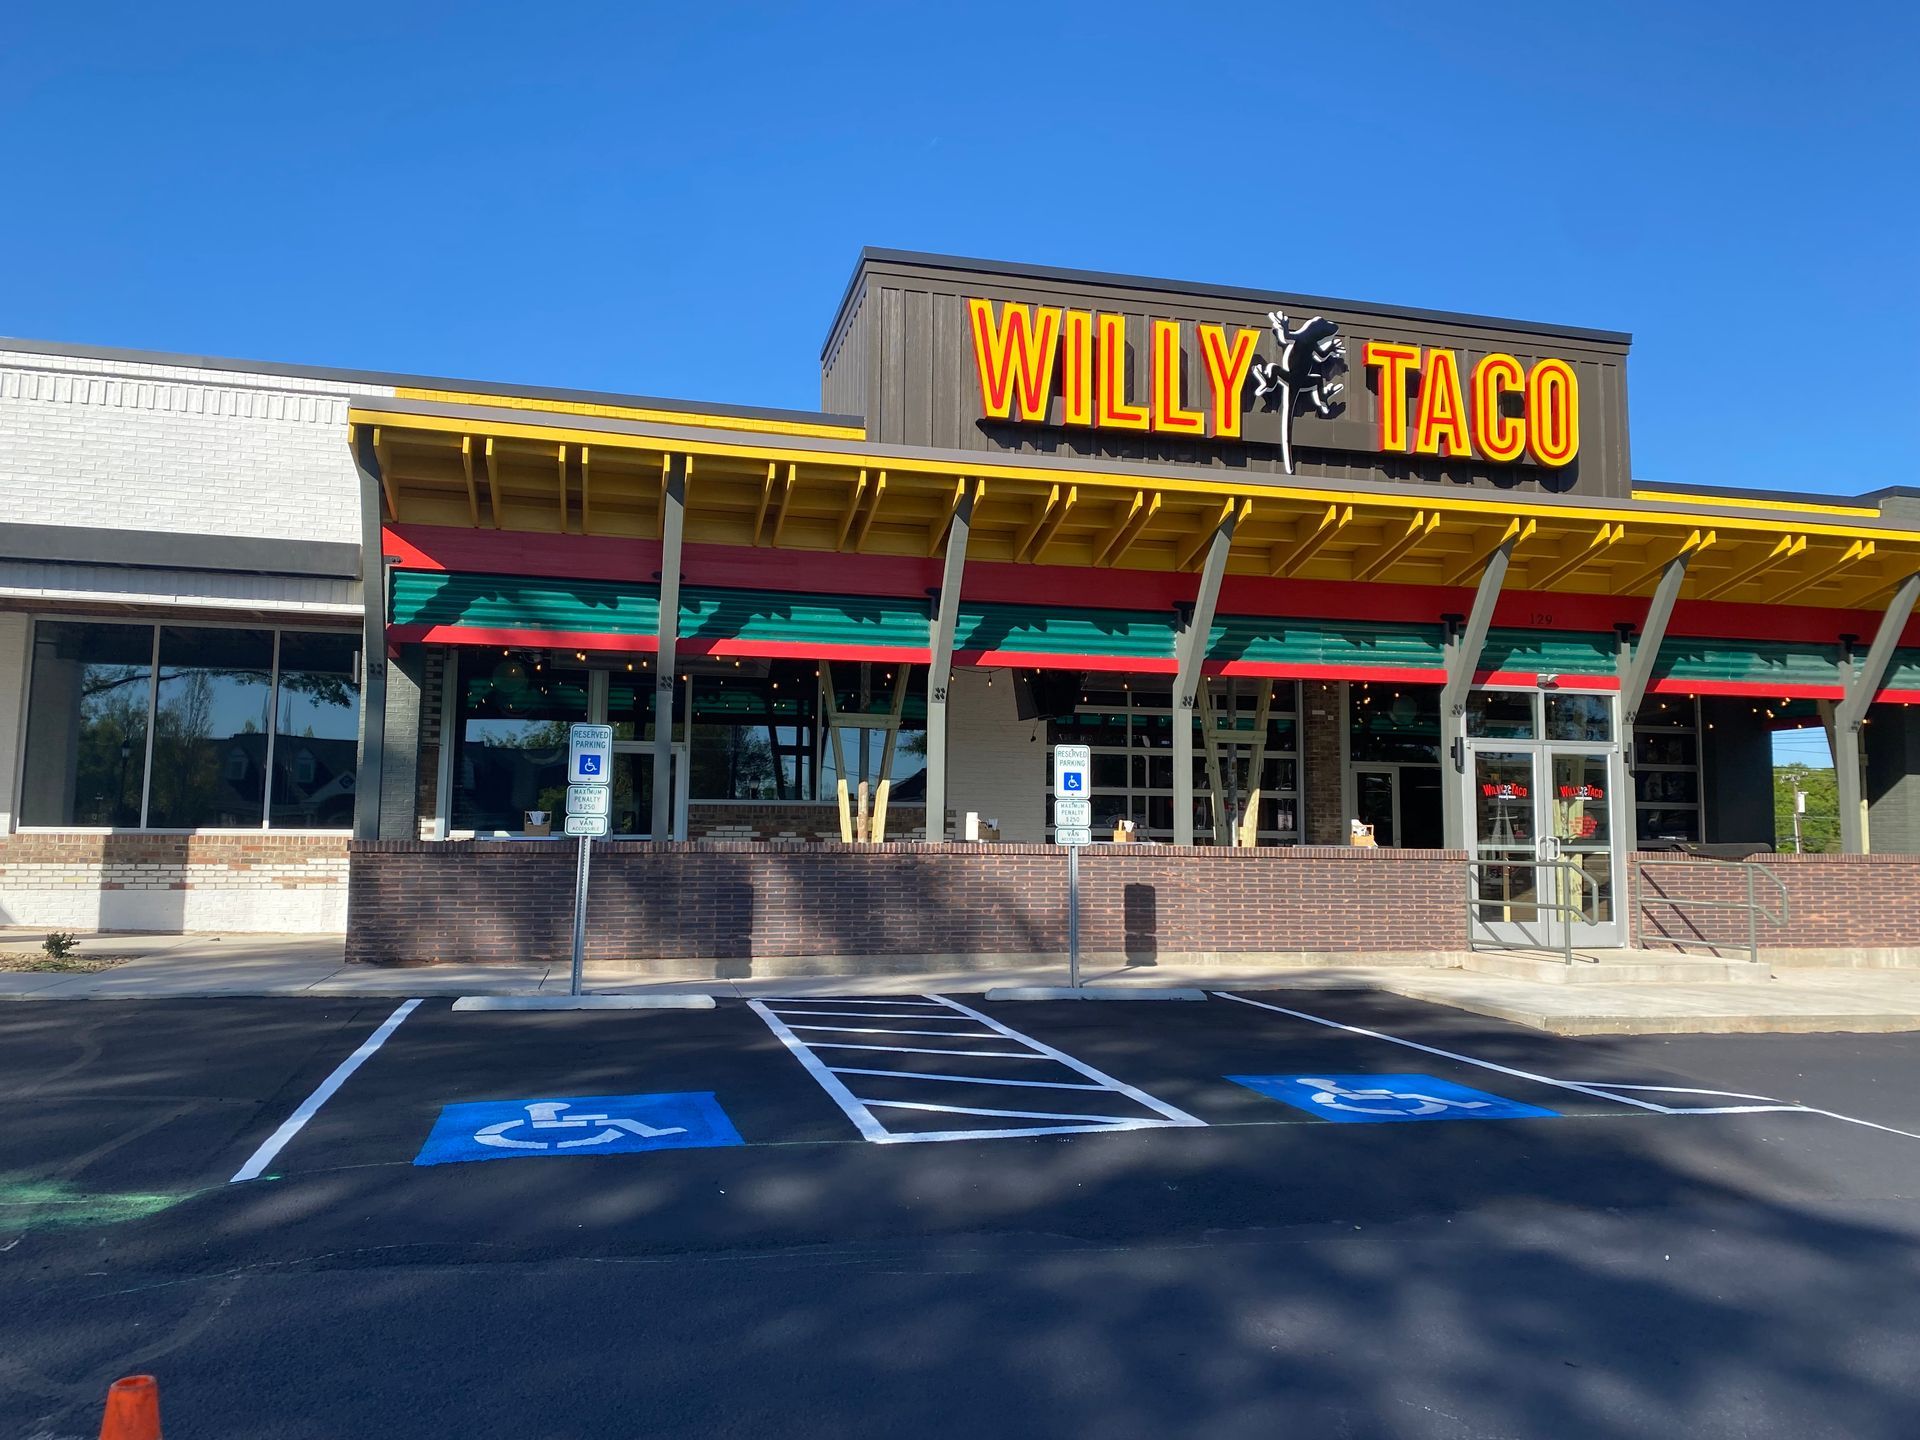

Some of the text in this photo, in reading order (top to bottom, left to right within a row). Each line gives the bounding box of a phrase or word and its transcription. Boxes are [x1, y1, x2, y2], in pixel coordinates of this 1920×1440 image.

[967, 298, 1580, 467] WILLY TACO
[1530, 613, 1553, 625] 129
[574, 730, 609, 739] RESERVED
[576, 740, 606, 749] PARKING
[1058, 750, 1087, 758] RESERVED
[1483, 783, 1528, 797] WILLY TACO
[1560, 784, 1604, 798] WILLY TACO
